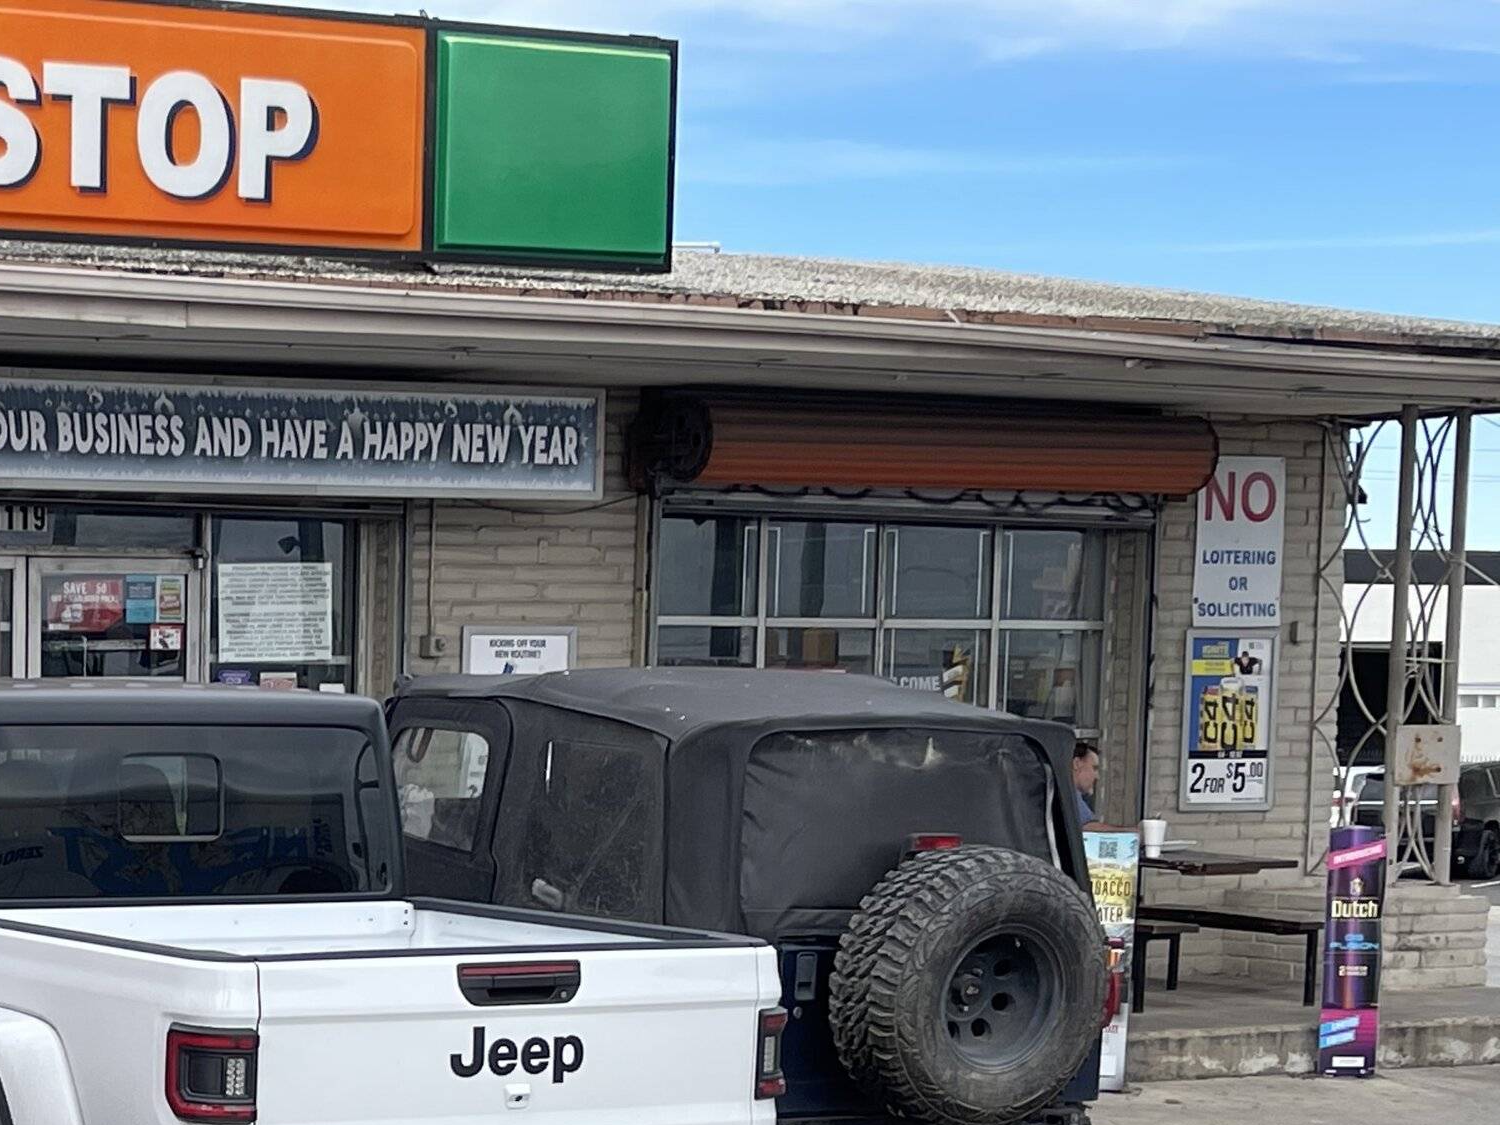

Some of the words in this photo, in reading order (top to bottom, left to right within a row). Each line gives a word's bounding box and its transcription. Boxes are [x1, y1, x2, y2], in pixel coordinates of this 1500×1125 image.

[57, 411, 185, 457] BUSINESS
[193, 416, 253, 458] AND
[260, 418, 329, 460] HAVE
[335, 420, 354, 460] A
[362, 421, 445, 463] HAPPY
[451, 423, 510, 464] NEW
[520, 425, 579, 466] YEAR
[1204, 471, 1277, 522] NO
[1202, 551, 1276, 565] LOITERING
[1228, 576, 1248, 590] OR
[1198, 602, 1276, 617] SOLICITING
[1203, 700, 1218, 743] C4
[1220, 694, 1238, 749] C4
[1243, 698, 1255, 743] C4
[1190, 762, 1205, 793] 2
[1204, 777, 1226, 793] FOR
[1097, 906, 1123, 922] ATER
[1331, 899, 1378, 918] Dutch
[450, 1026, 584, 1084] Jeep
